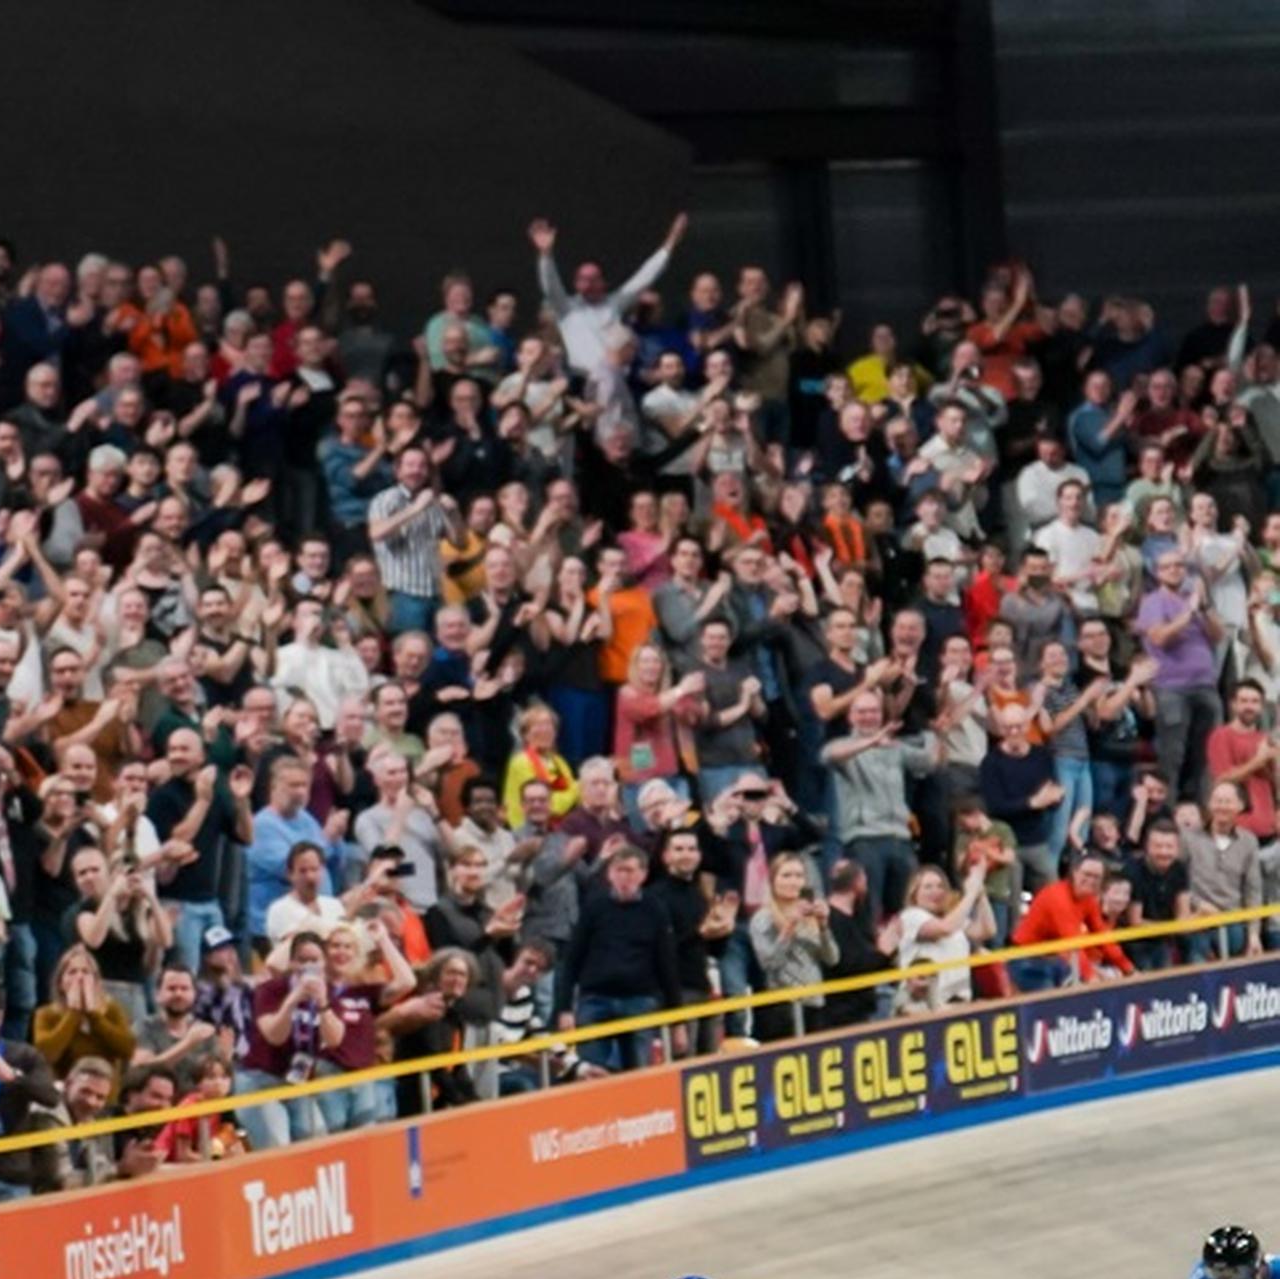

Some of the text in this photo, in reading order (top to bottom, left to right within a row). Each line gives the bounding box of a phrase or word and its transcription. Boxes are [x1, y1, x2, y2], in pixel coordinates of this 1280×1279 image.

[1047, 1009, 1113, 1058] vittoria
[1140, 993, 1208, 1041] vittoria
[243, 1161, 353, 1257] TeamNL
